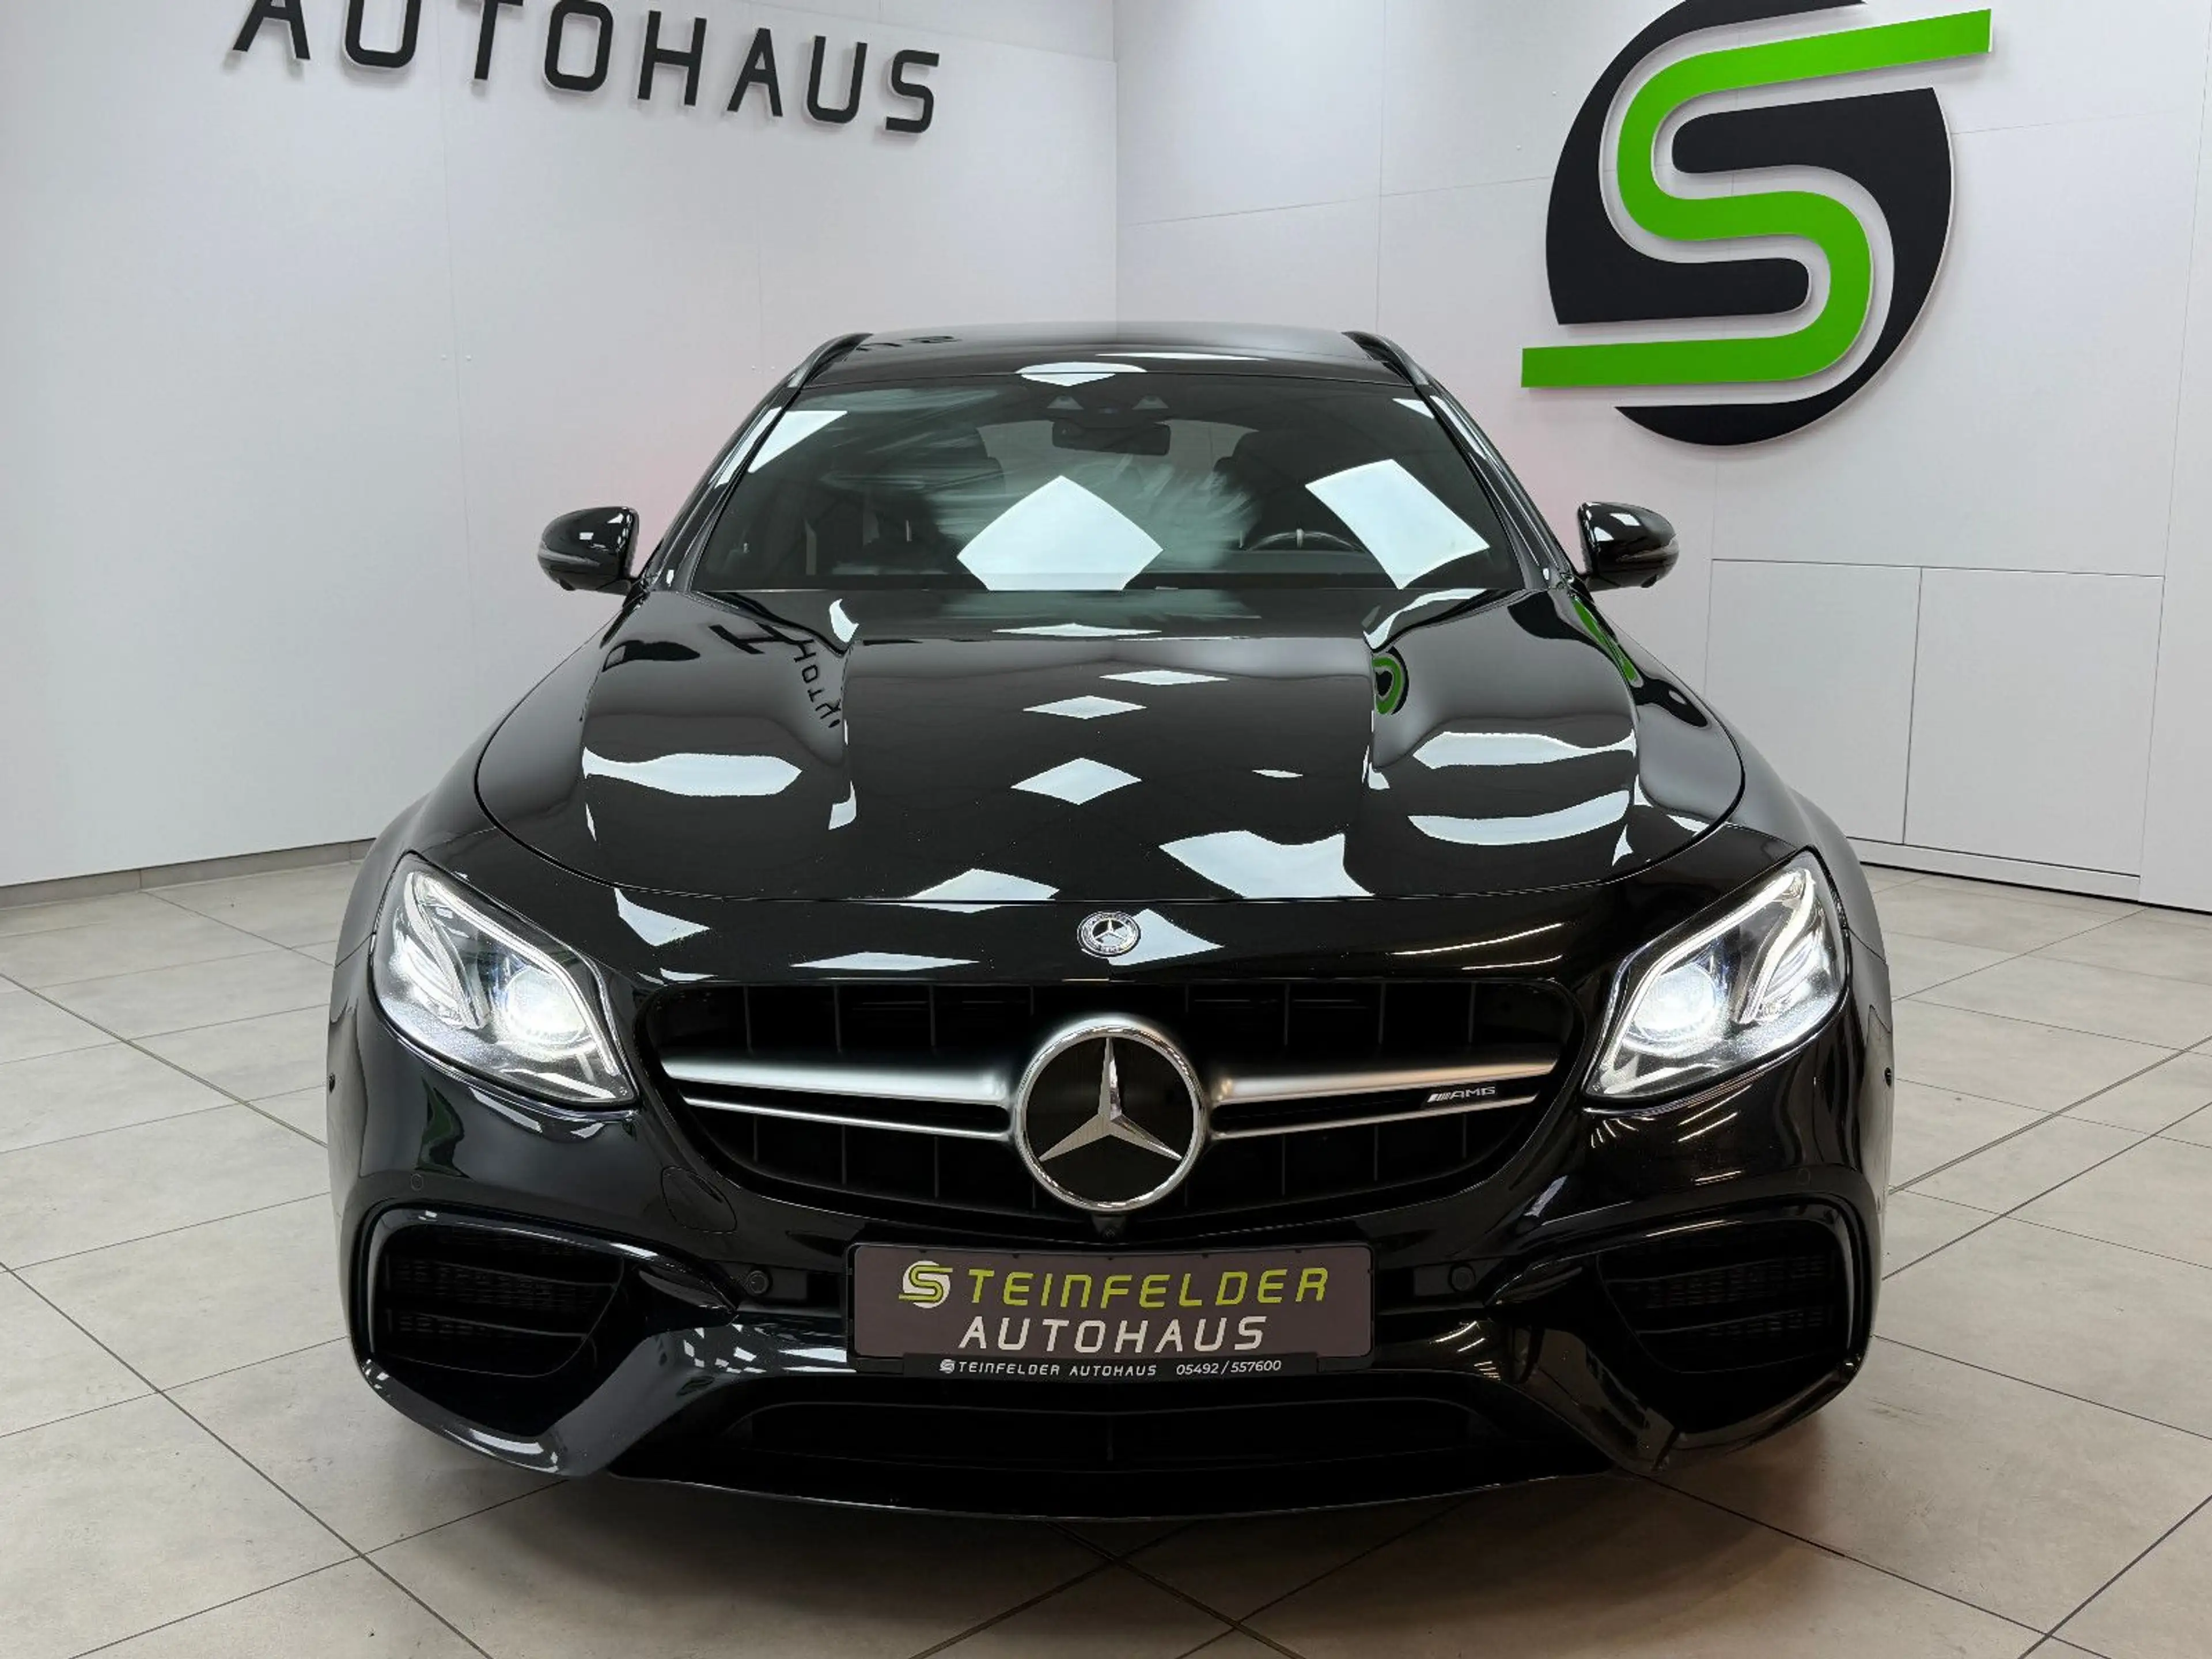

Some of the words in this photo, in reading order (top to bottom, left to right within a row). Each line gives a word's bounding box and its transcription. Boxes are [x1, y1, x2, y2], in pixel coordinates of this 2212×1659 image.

[232, 0, 940, 134] AUTOHAUS
[899, 1260, 1328, 1309] STEINFELDER
[958, 1316, 1267, 1353] AUTOHAUS
[1069, 1365, 1156, 1377] AUTOHAUS
